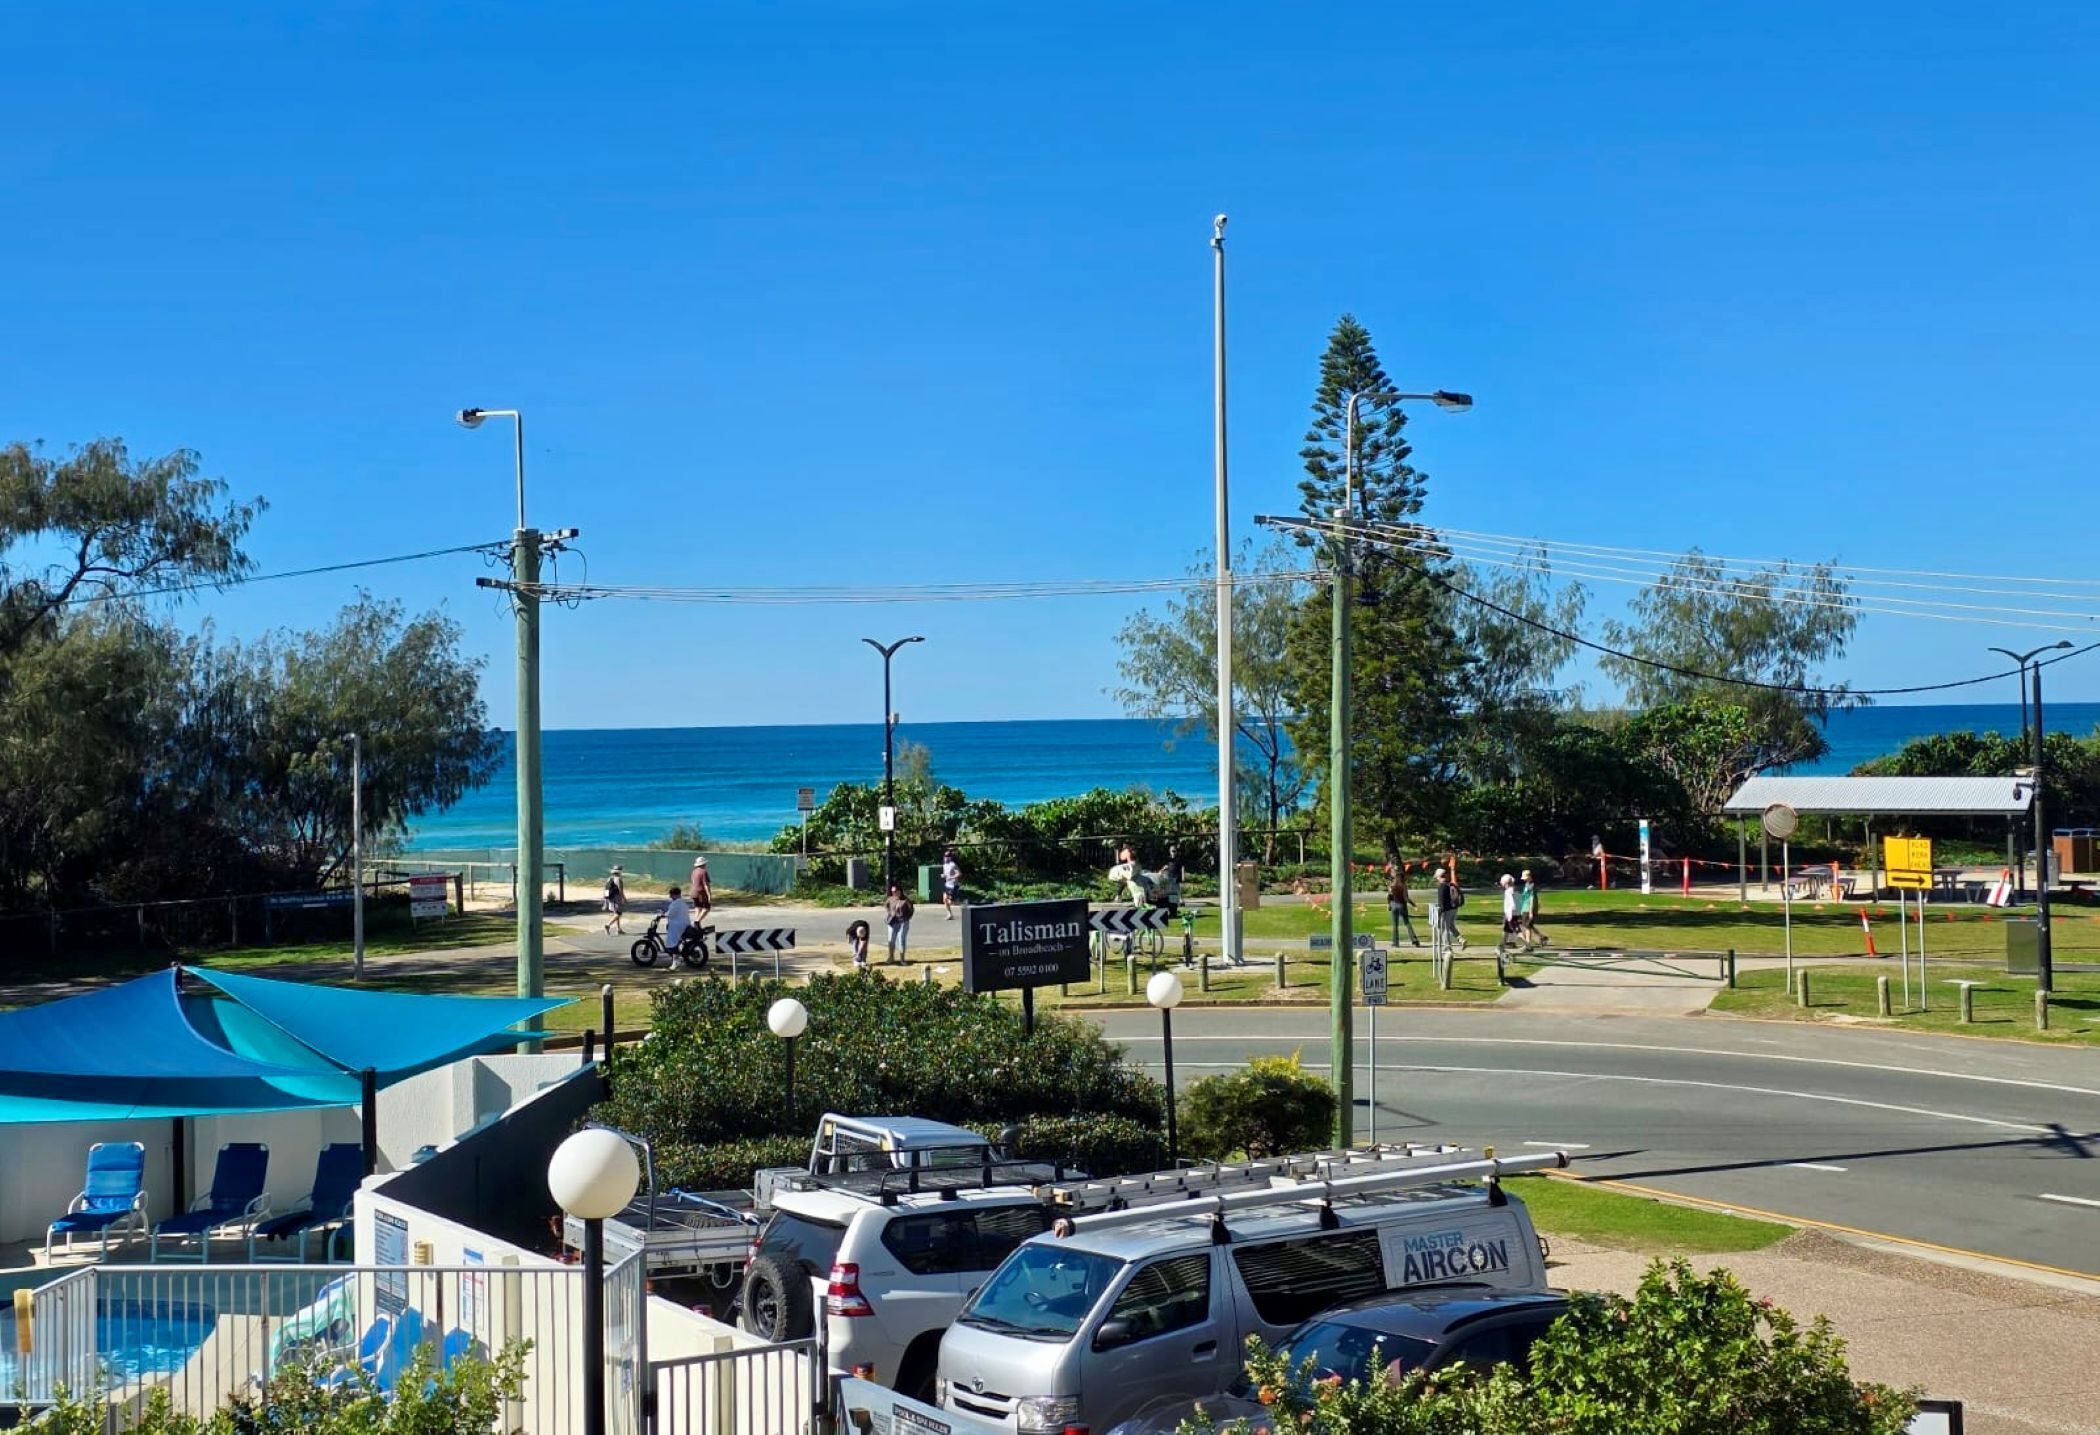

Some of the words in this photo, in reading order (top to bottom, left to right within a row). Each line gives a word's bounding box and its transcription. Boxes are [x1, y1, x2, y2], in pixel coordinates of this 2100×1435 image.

[980, 921, 1080, 945] Talisman
[1012, 941, 1064, 956] Broadbeach
[1004, 966, 1015, 977] 07
[1366, 978, 1384, 989] LANE
[1403, 1231, 1464, 1252] MASTER
[1403, 1239, 1509, 1283] AIRCON
